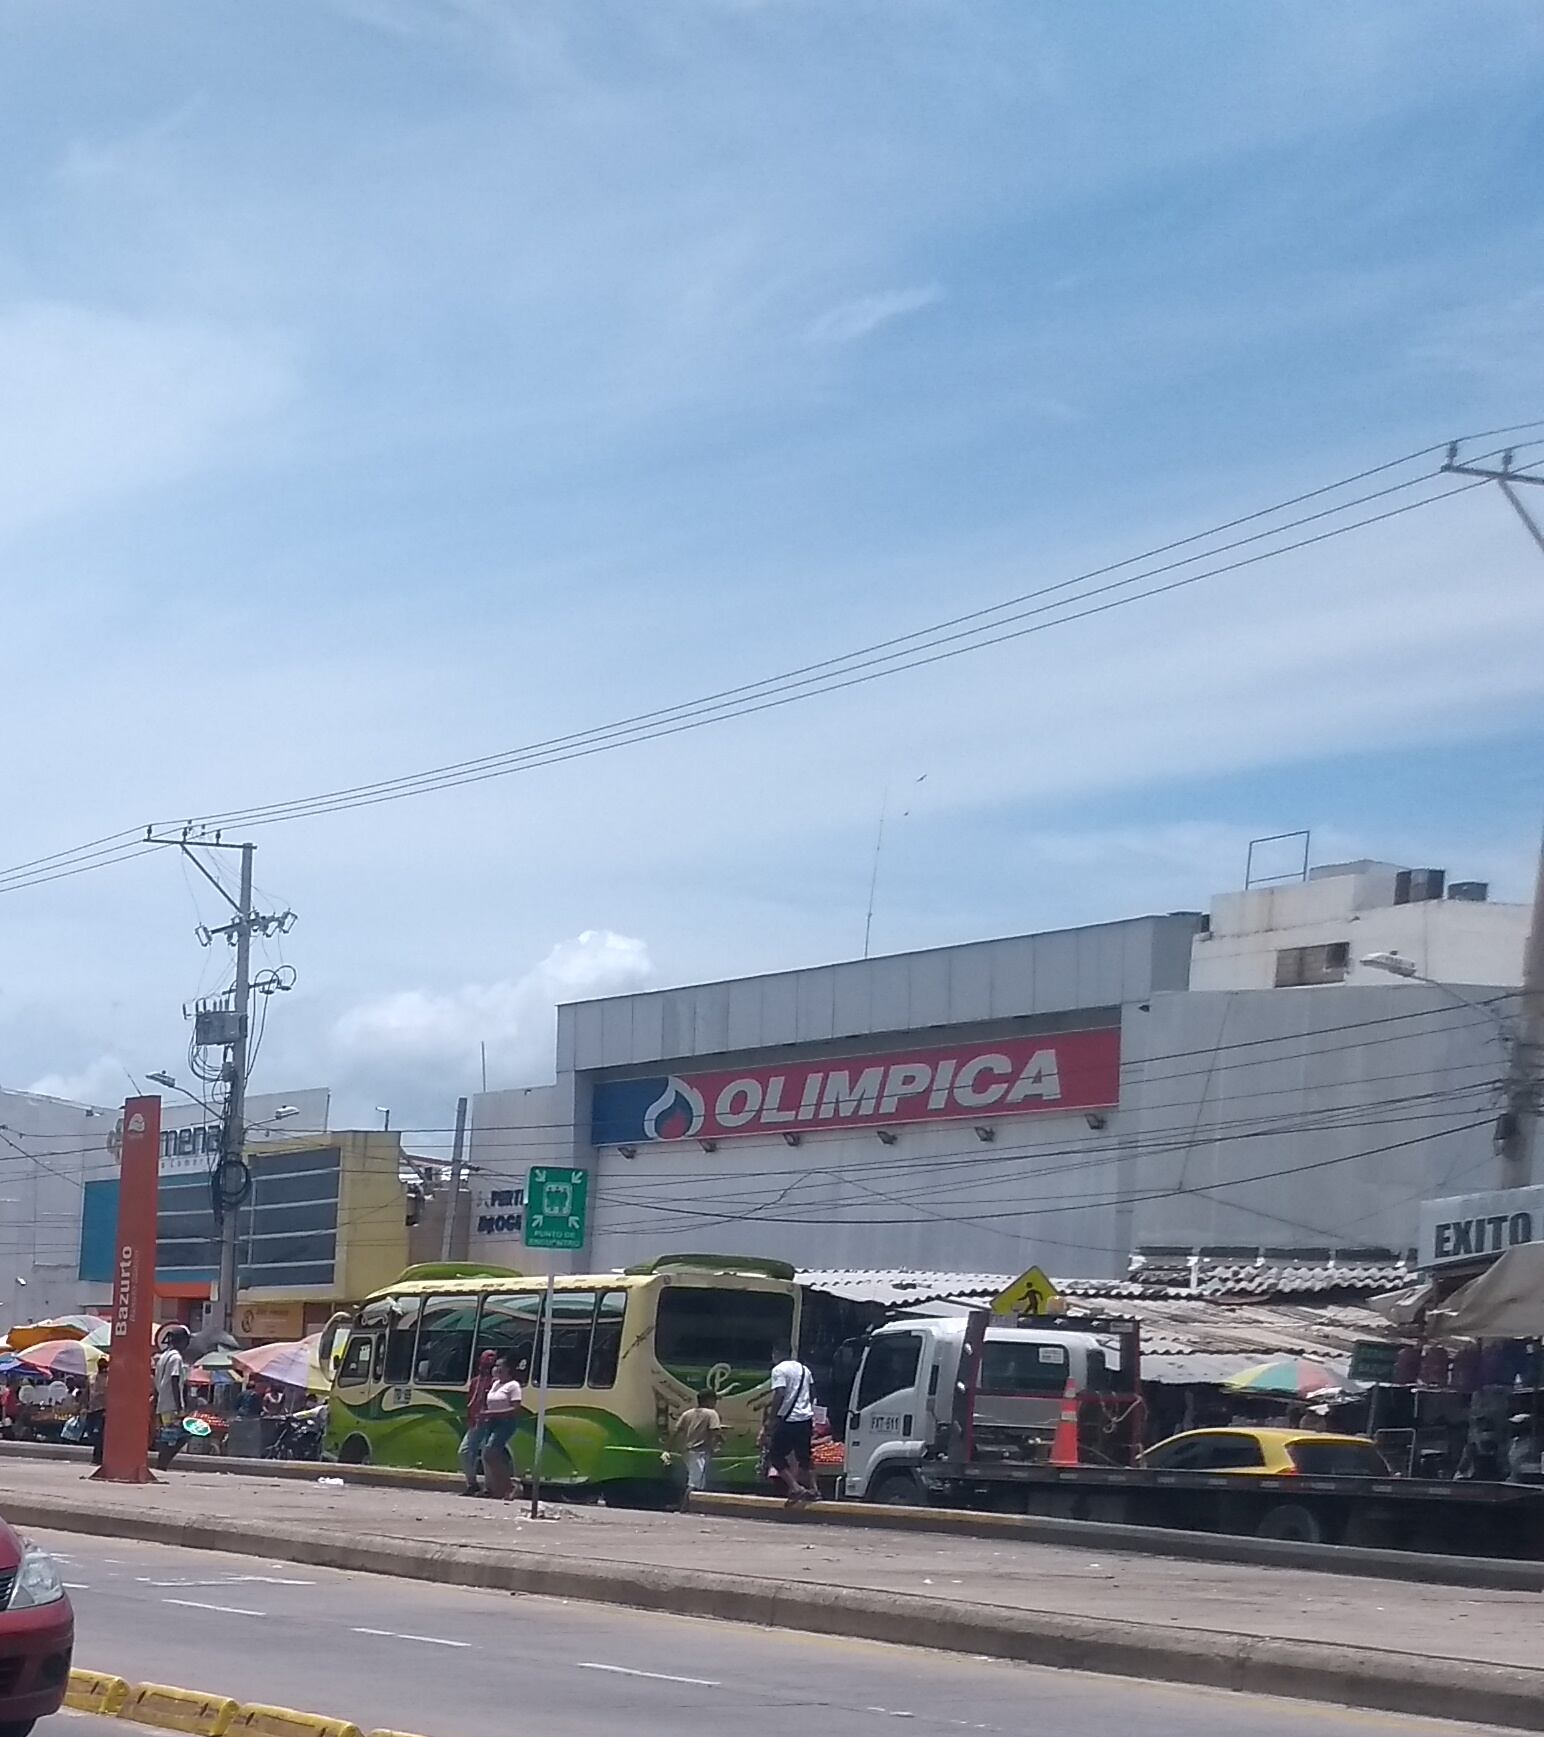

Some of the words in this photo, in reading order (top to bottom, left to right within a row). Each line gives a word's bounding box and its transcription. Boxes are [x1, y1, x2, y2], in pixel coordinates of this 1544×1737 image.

[714, 1048, 1063, 1129] OLIMPICA
[1435, 1212, 1532, 1259] EXITO
[115, 1246, 133, 1336] Bazurto
